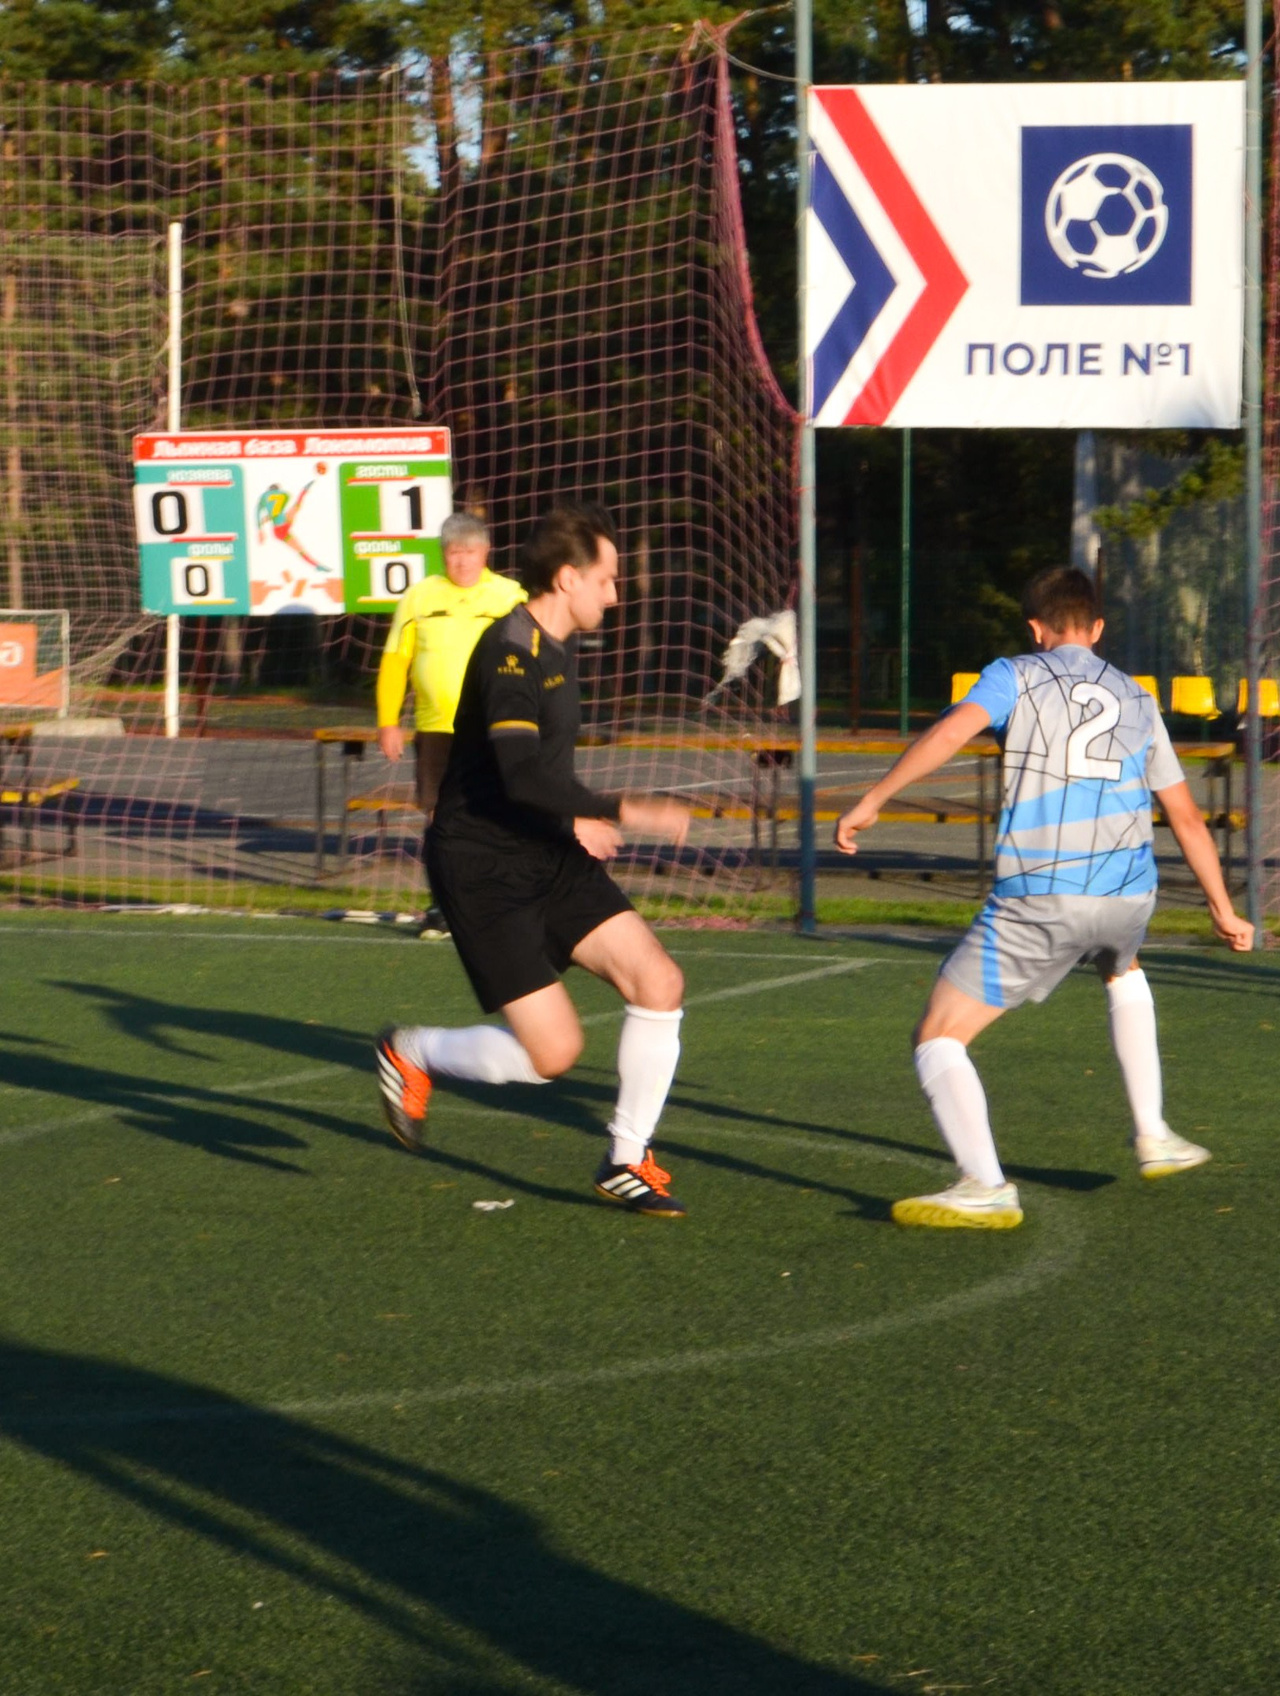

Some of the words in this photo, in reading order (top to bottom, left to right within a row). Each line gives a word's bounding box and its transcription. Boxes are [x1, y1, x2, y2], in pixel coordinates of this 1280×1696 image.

[965, 341, 1104, 377] ПОЛЕ
[1121, 341, 1193, 377] №1
[151, 491, 188, 535] 0
[402, 486, 423, 530] 1
[185, 564, 210, 597] 0
[385, 562, 410, 594] 0
[1066, 681, 1122, 781] 2
